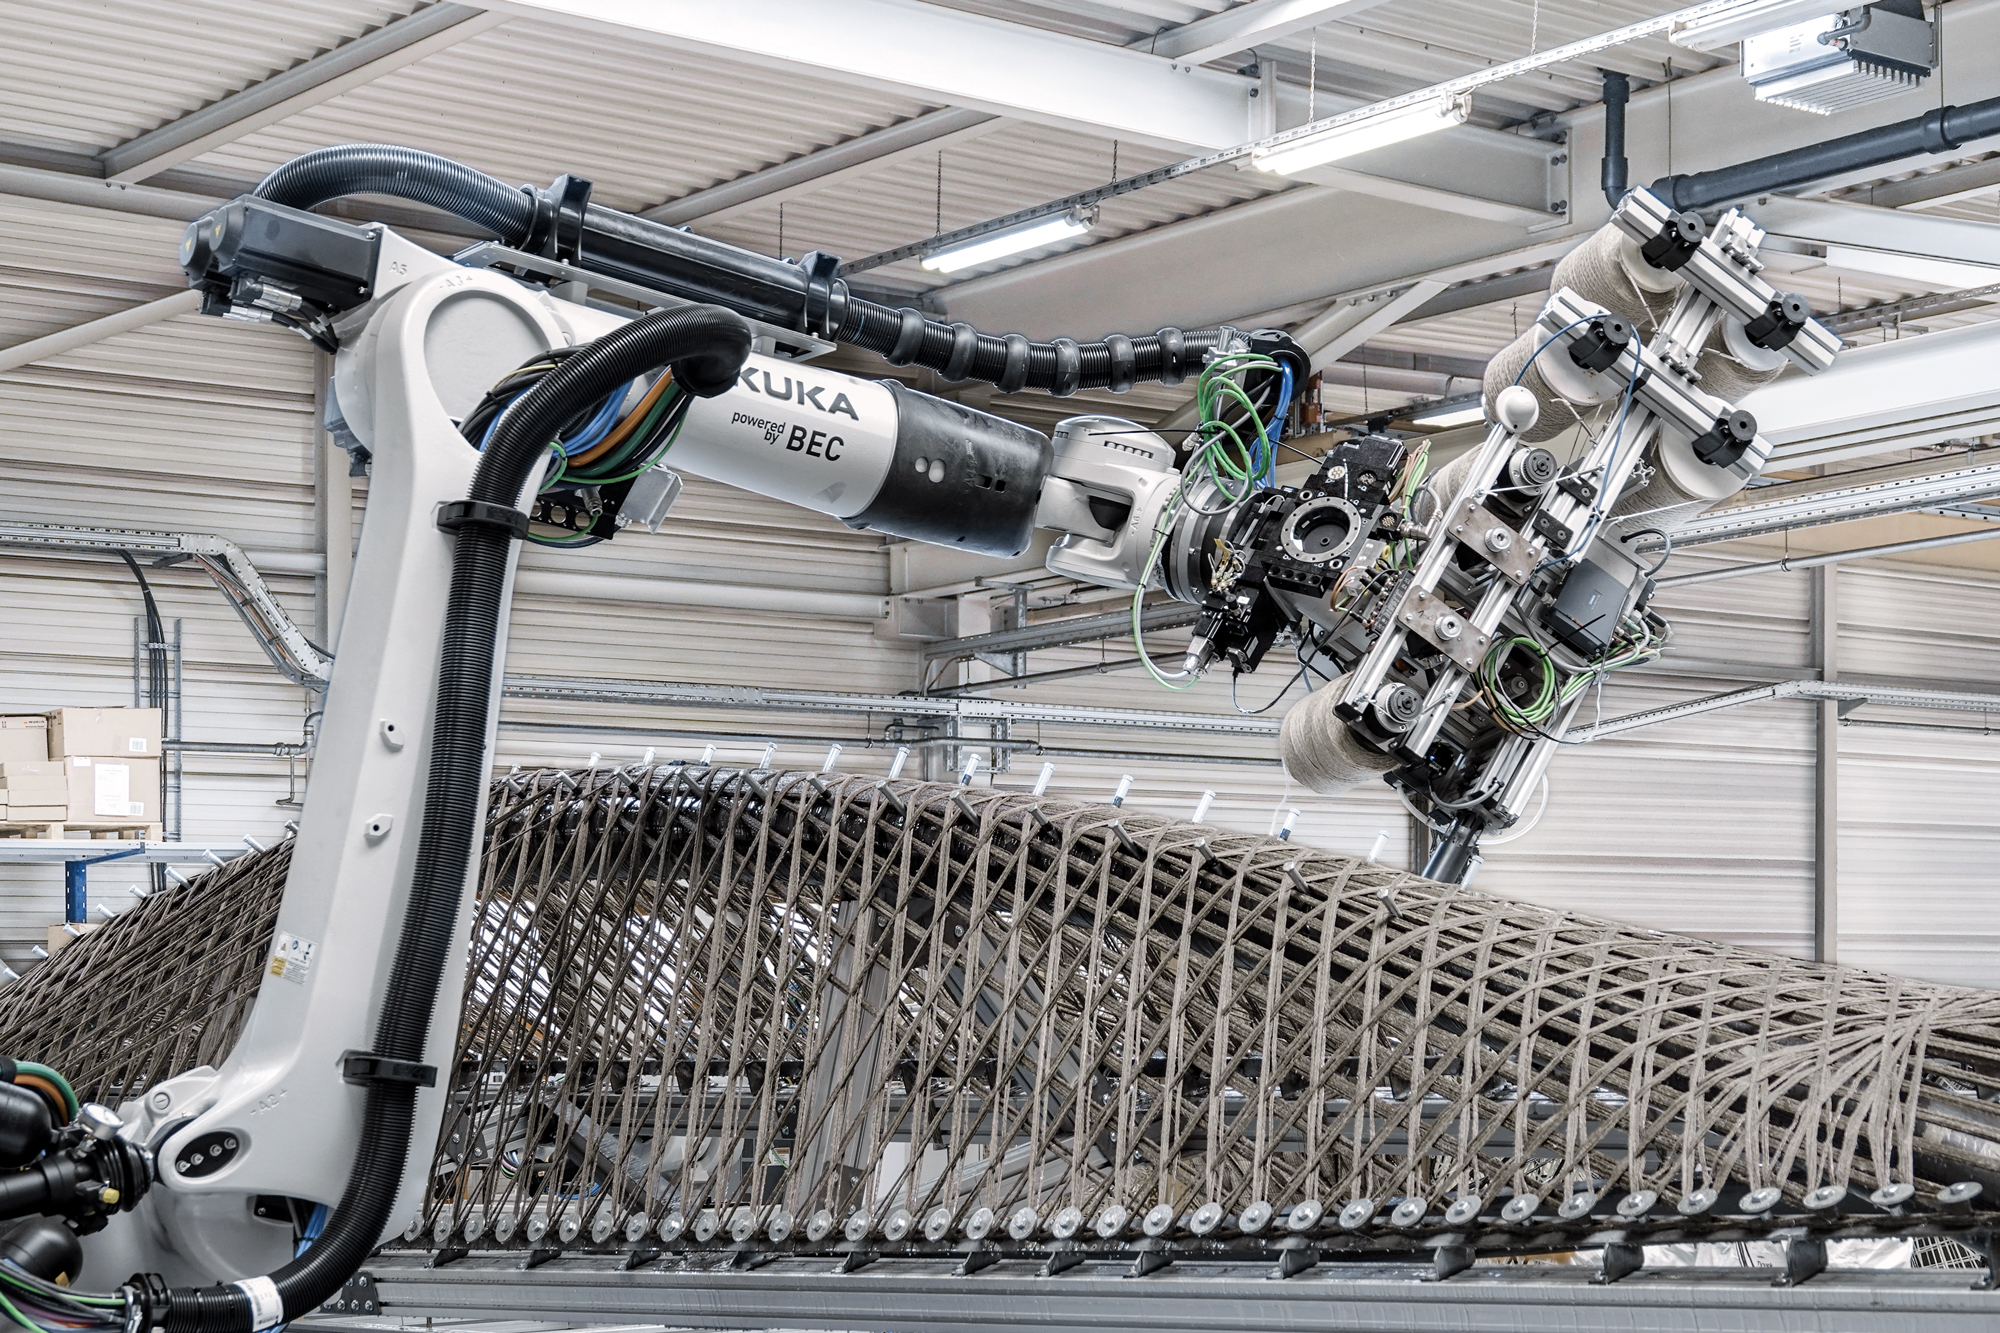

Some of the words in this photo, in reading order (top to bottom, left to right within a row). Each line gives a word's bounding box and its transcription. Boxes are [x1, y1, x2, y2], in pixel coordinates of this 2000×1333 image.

[735, 367, 859, 421] KUKA
[731, 412, 786, 434] powered
[764, 428, 779, 445] by
[786, 425, 844, 461] BEC
